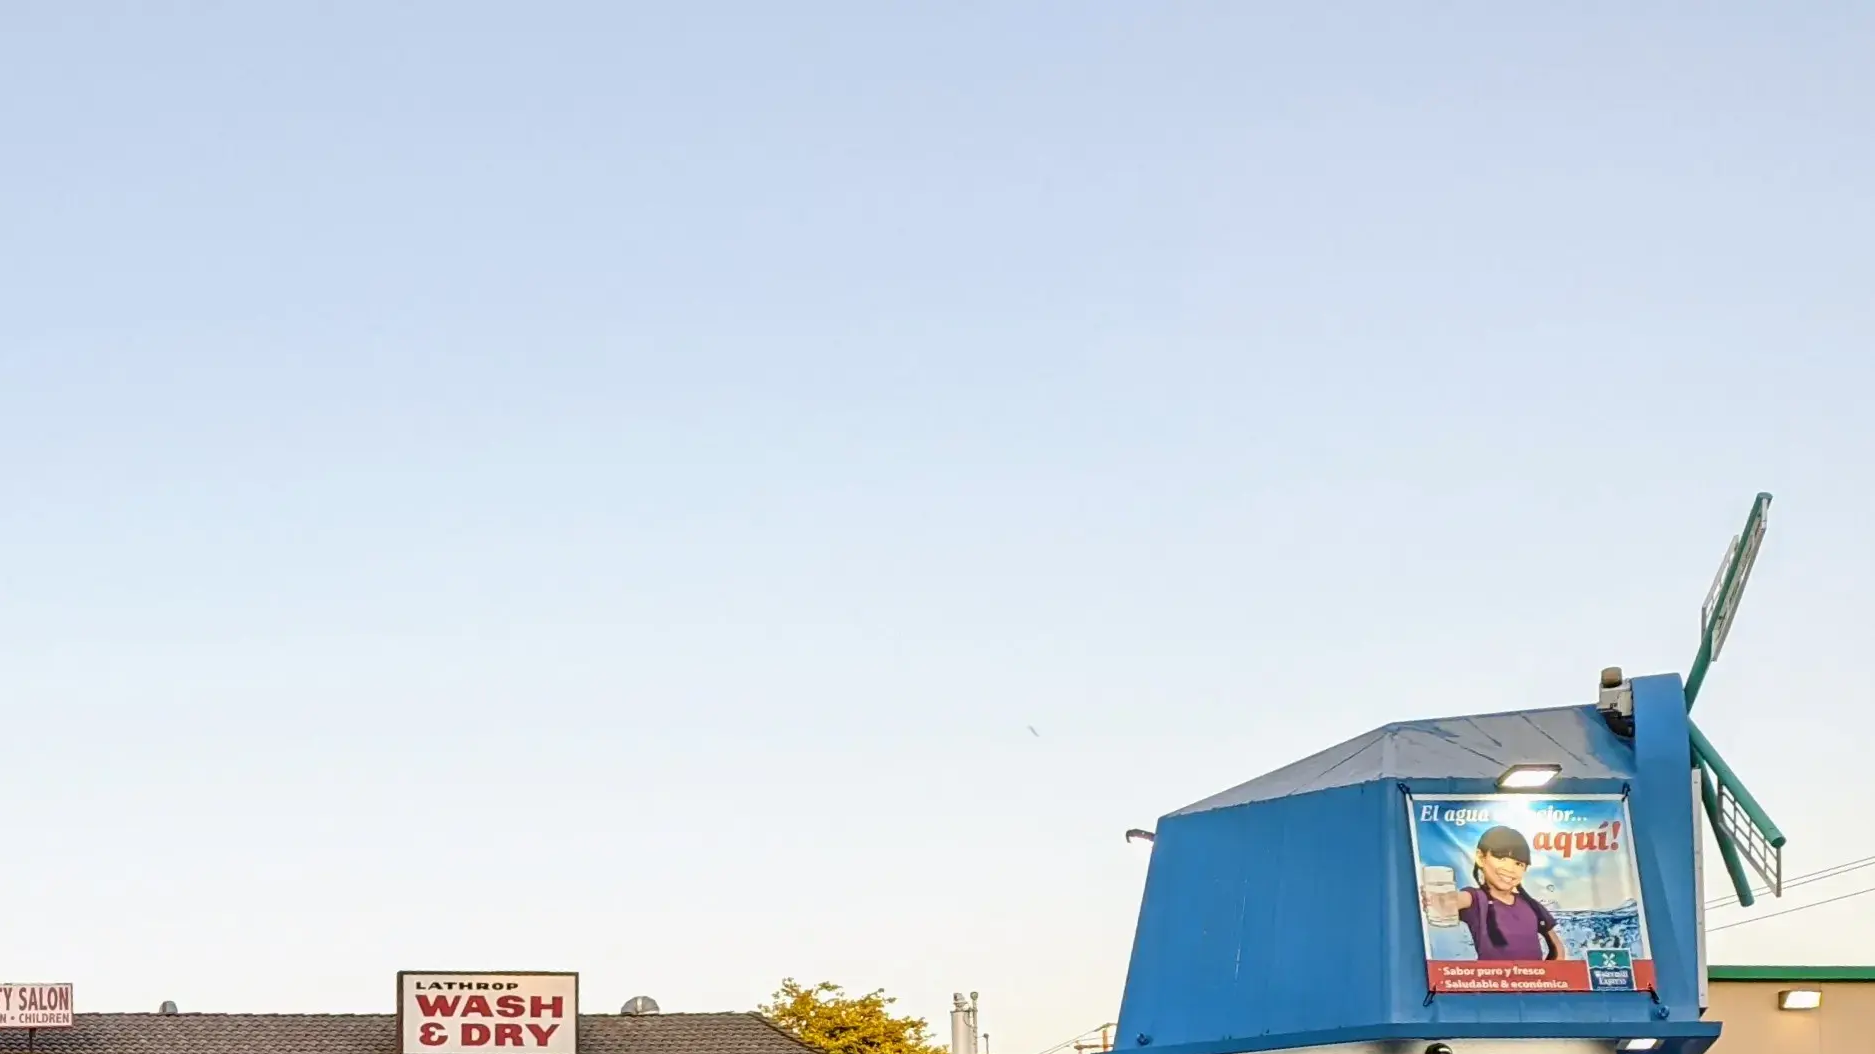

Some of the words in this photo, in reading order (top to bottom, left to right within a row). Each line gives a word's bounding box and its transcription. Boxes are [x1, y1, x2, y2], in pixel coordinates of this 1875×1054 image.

[1421, 804, 1439, 822] El
[1444, 809, 1490, 825] agua
[1533, 820, 1621, 858] aquí!
[1443, 966, 1474, 976] Sabor
[1477, 968, 1502, 978] puro
[1504, 969, 1511, 978] y
[1513, 966, 1546, 976] fresco
[415, 981, 519, 991] LATHROP
[1445, 979, 1499, 989] Saludable
[1501, 980, 1509, 989] &
[1511, 978, 1568, 989] económica
[19, 987, 69, 1011] SALON
[415, 994, 564, 1019] WASH
[19, 1013, 70, 1024] CHILDREN
[419, 1022, 449, 1047] &
[460, 1023, 560, 1047] DRY
